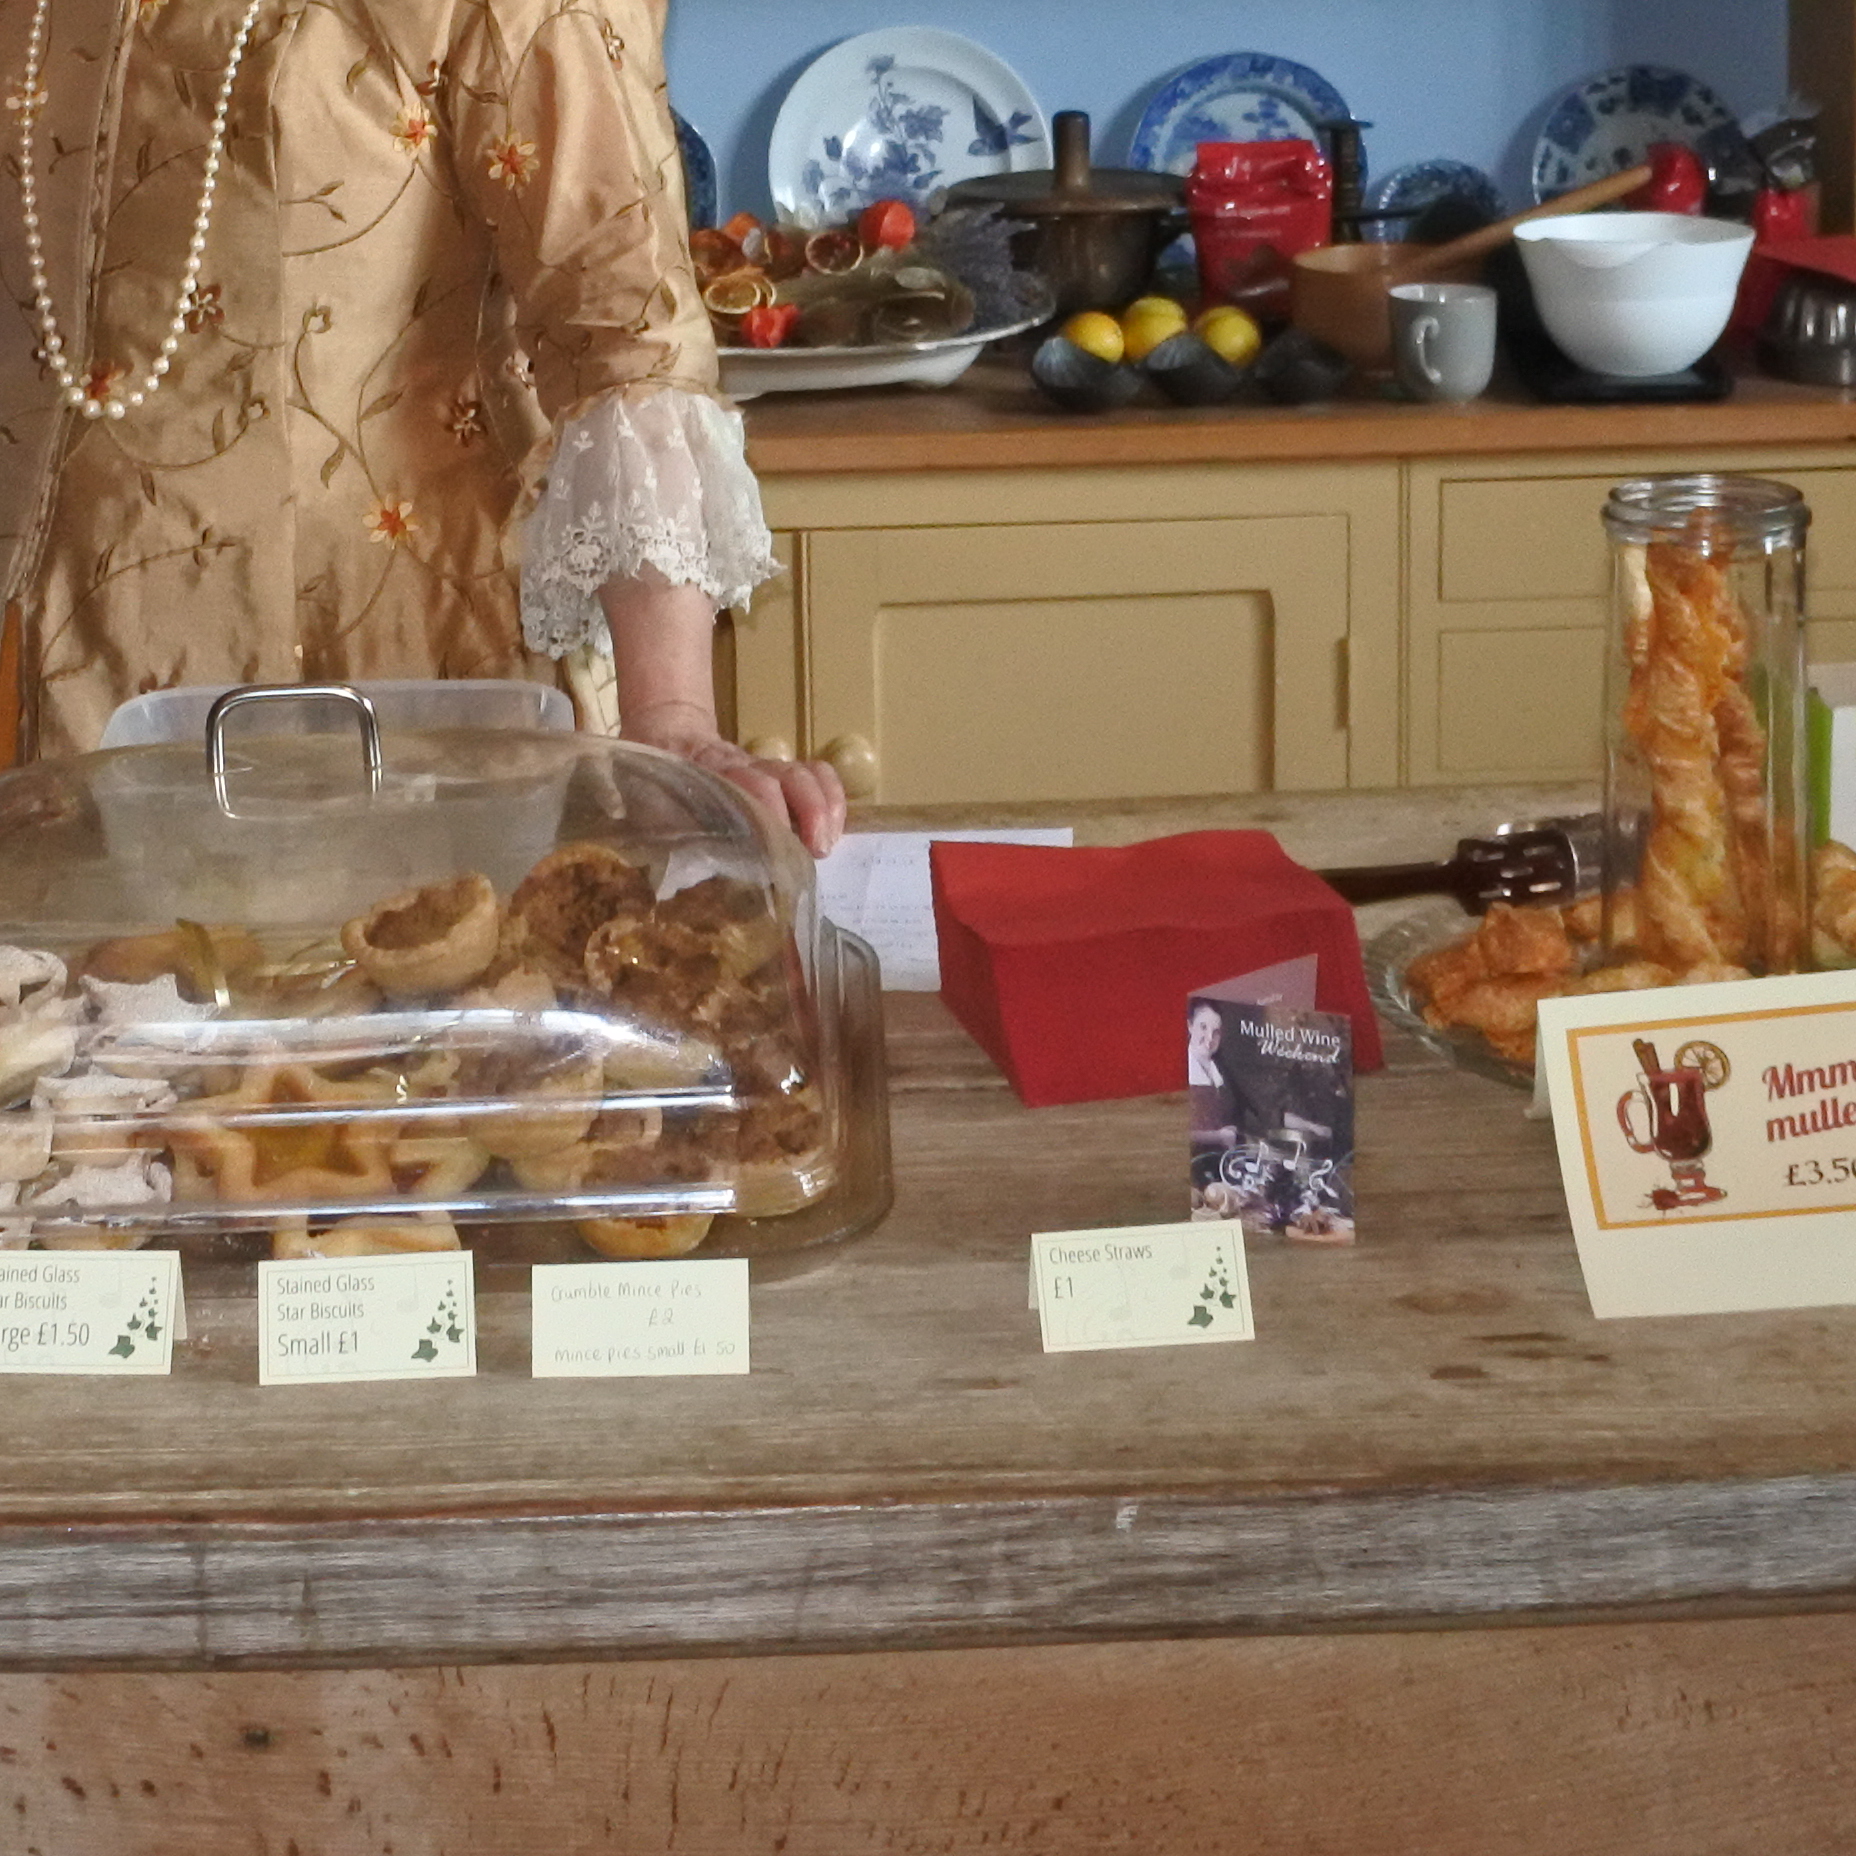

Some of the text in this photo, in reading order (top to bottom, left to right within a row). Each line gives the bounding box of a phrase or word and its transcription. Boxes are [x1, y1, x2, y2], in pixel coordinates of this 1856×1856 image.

[1240, 1019, 1341, 1047] Mulled Wine
[1258, 1039, 1341, 1064] Weekend
[1049, 1244, 1153, 1265] Cheese Straws
[42, 1264, 81, 1284] Glass
[277, 1273, 375, 1295] Stained Glass
[1054, 1276, 1074, 1299] £1
[14, 1291, 68, 1311] Biscuits
[277, 1301, 365, 1322] Star Biscuits
[37, 1321, 90, 1347] £1.50
[278, 1331, 359, 1357] Small £1
